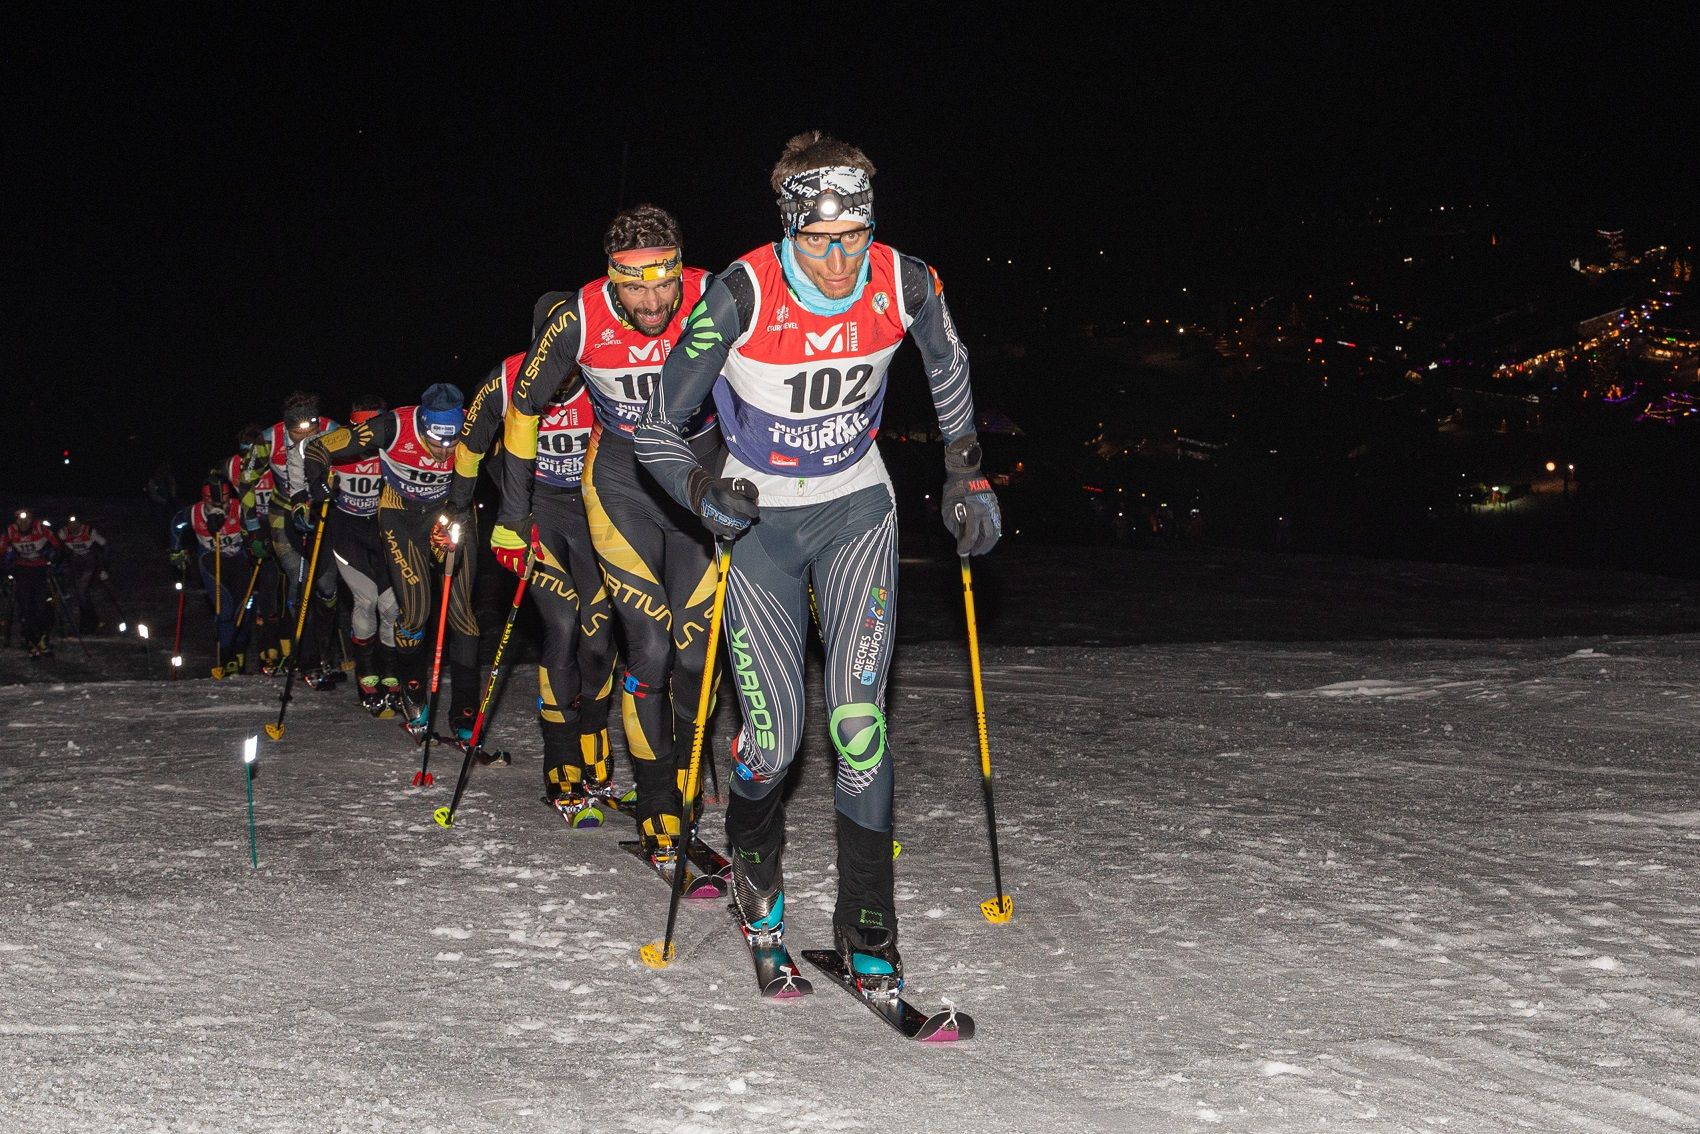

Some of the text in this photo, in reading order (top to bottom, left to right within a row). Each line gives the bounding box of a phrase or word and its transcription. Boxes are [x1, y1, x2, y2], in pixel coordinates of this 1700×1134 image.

[525, 310, 578, 381] SPORTIVA
[850, 320, 859, 352] MILLET
[470, 376, 503, 424] SPORTIVA
[615, 373, 661, 401] 10
[783, 363, 874, 413] 102
[774, 421, 818, 435] MILLET
[385, 529, 420, 585] KARPOS
[852, 635, 872, 680] ARECHES
[864, 620, 885, 672] BEAUFORT
[731, 626, 776, 751] KARPOS
